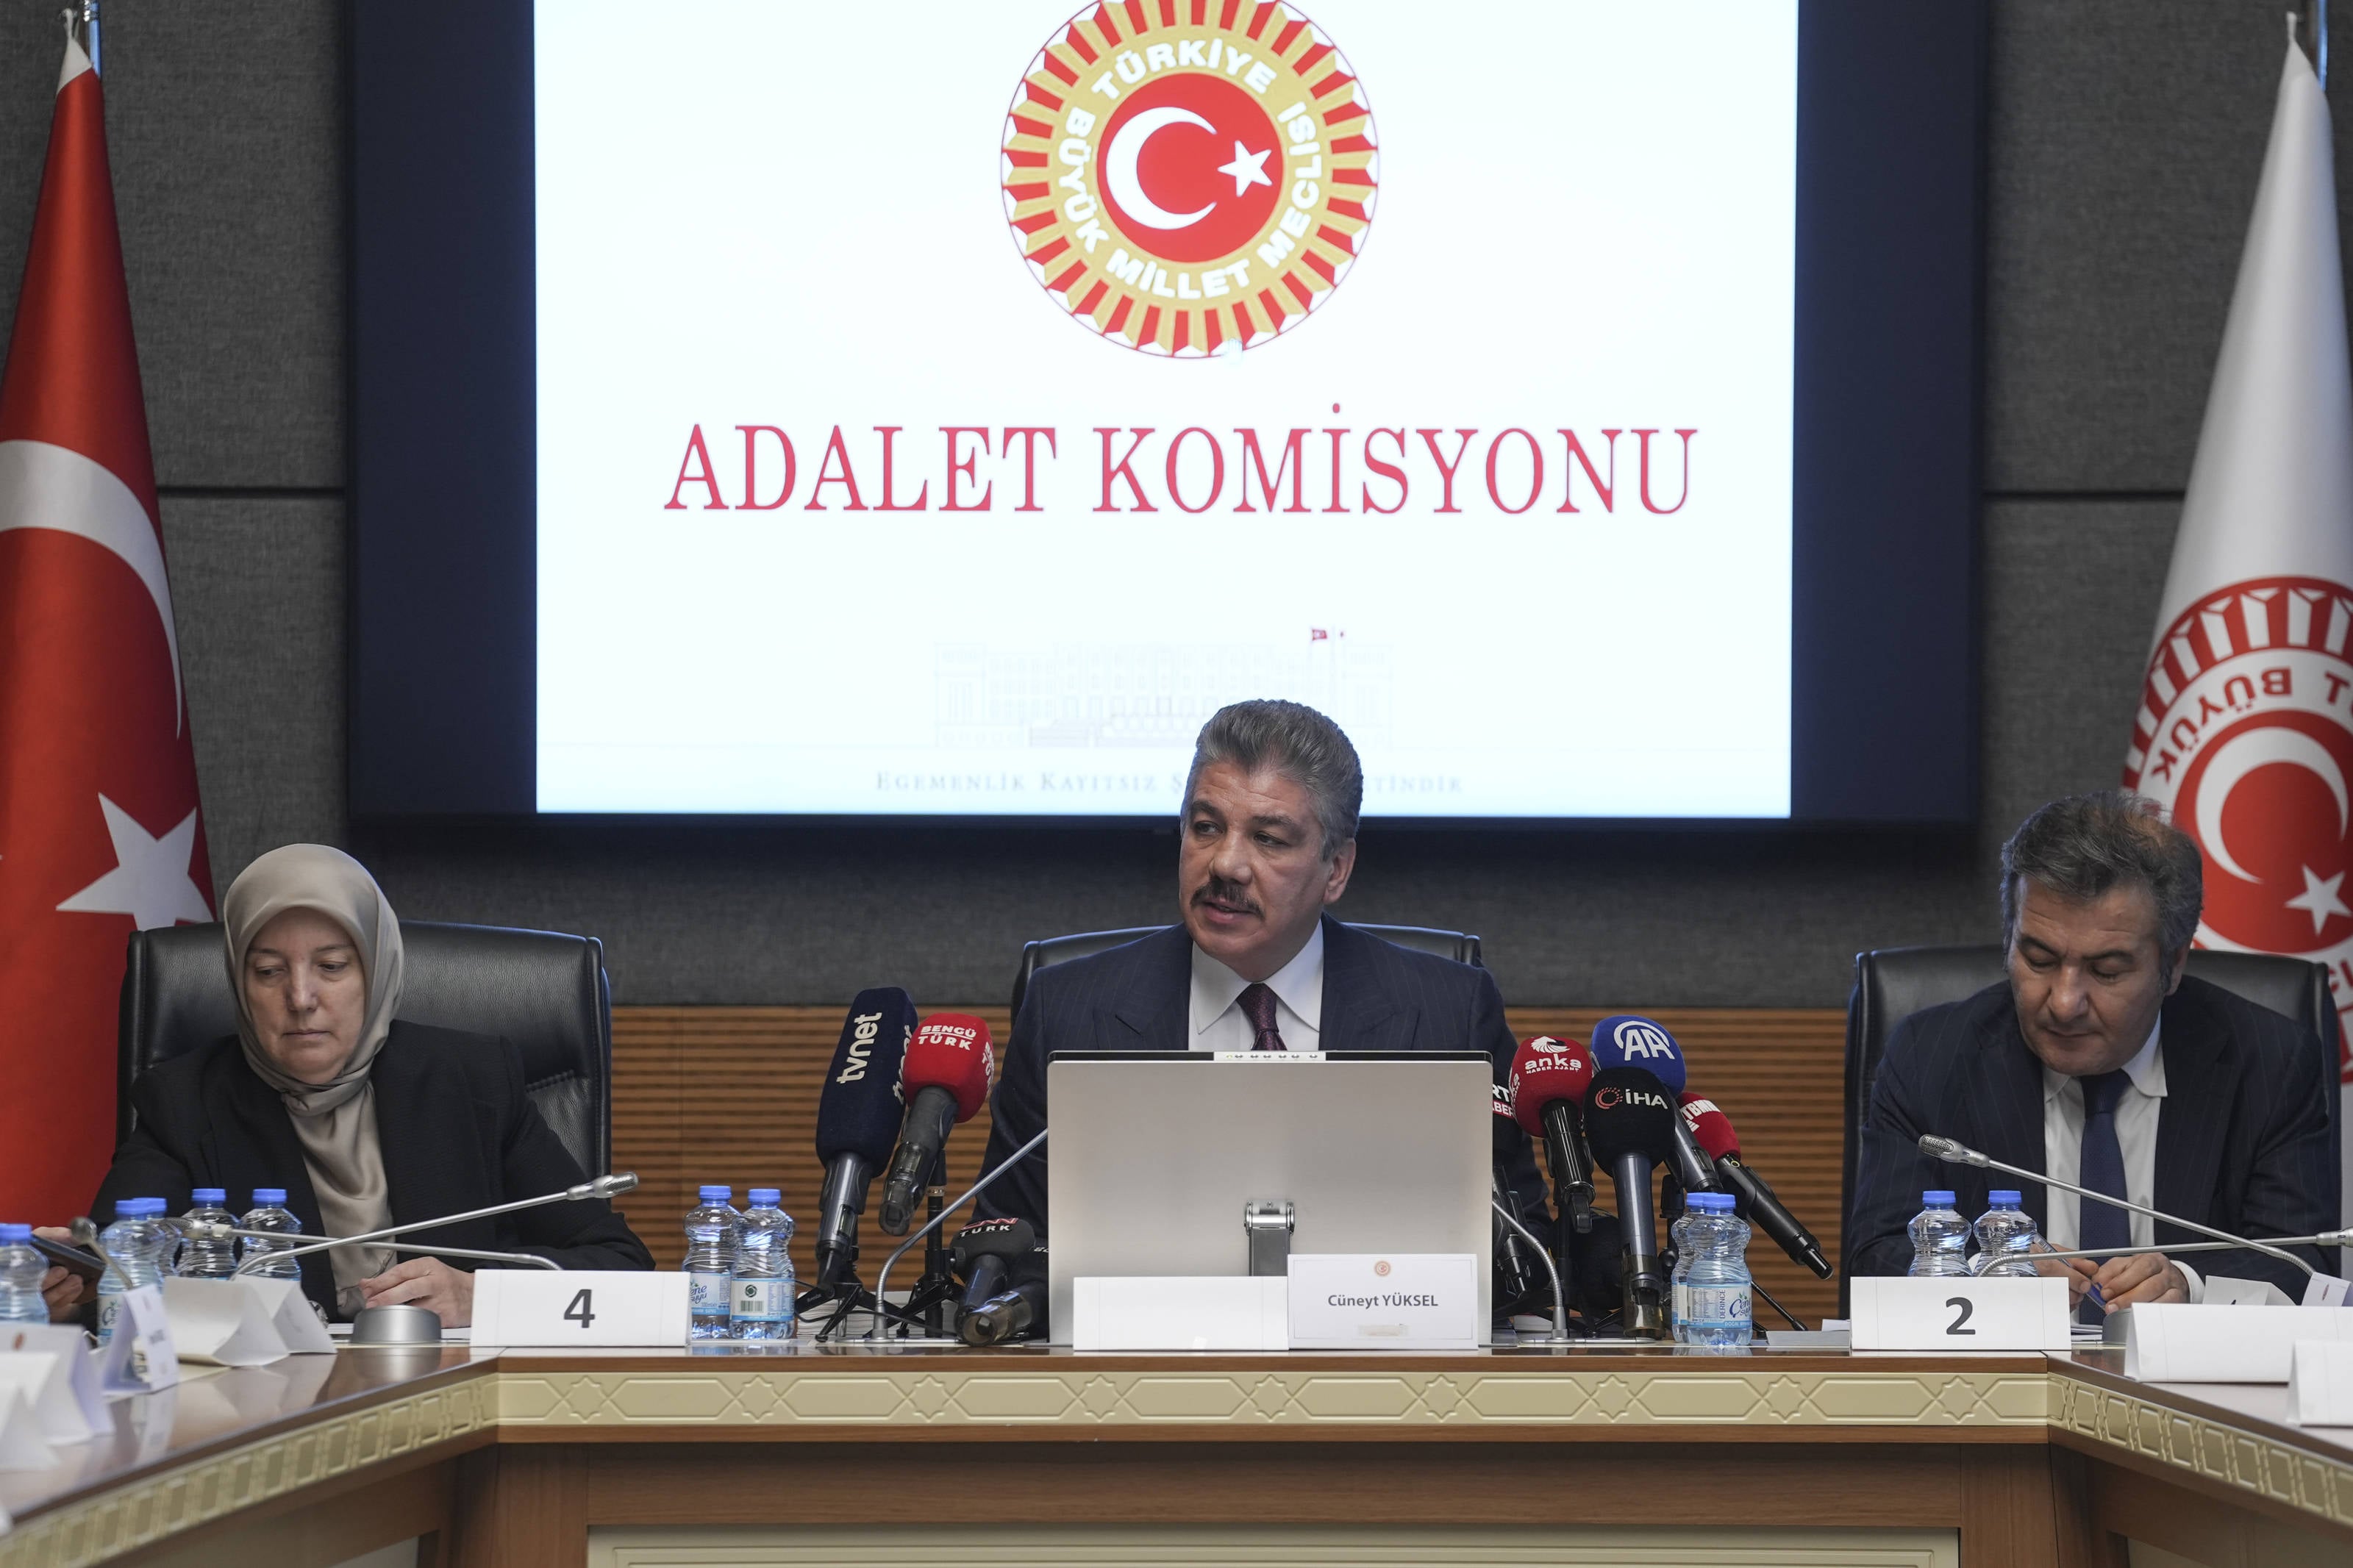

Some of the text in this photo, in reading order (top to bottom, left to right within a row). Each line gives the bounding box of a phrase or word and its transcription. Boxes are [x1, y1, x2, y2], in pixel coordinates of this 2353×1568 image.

[1090, 37, 1277, 100] TÜRKİYE
[1058, 107, 1110, 254] BÜYÜK
[1105, 248, 1250, 300] MİLLET
[664, 403, 1697, 515] ADALET KOMİSYONU
[2152, 667, 2293, 783] BÜYÜK
[836, 1012, 882, 1084] tvnet
[918, 1034, 972, 1050] TÜRK
[921, 1025, 976, 1038] BENGÜ
[1624, 1029, 1675, 1062] AA
[1524, 1053, 1582, 1070] anka
[1493, 1084, 1510, 1103] RT
[1626, 1089, 1668, 1109] İHA
[563, 1289, 596, 1328] 4
[1328, 1292, 1439, 1309] Cüneyt YÜKSEL
[1946, 1297, 1976, 1336] 2
